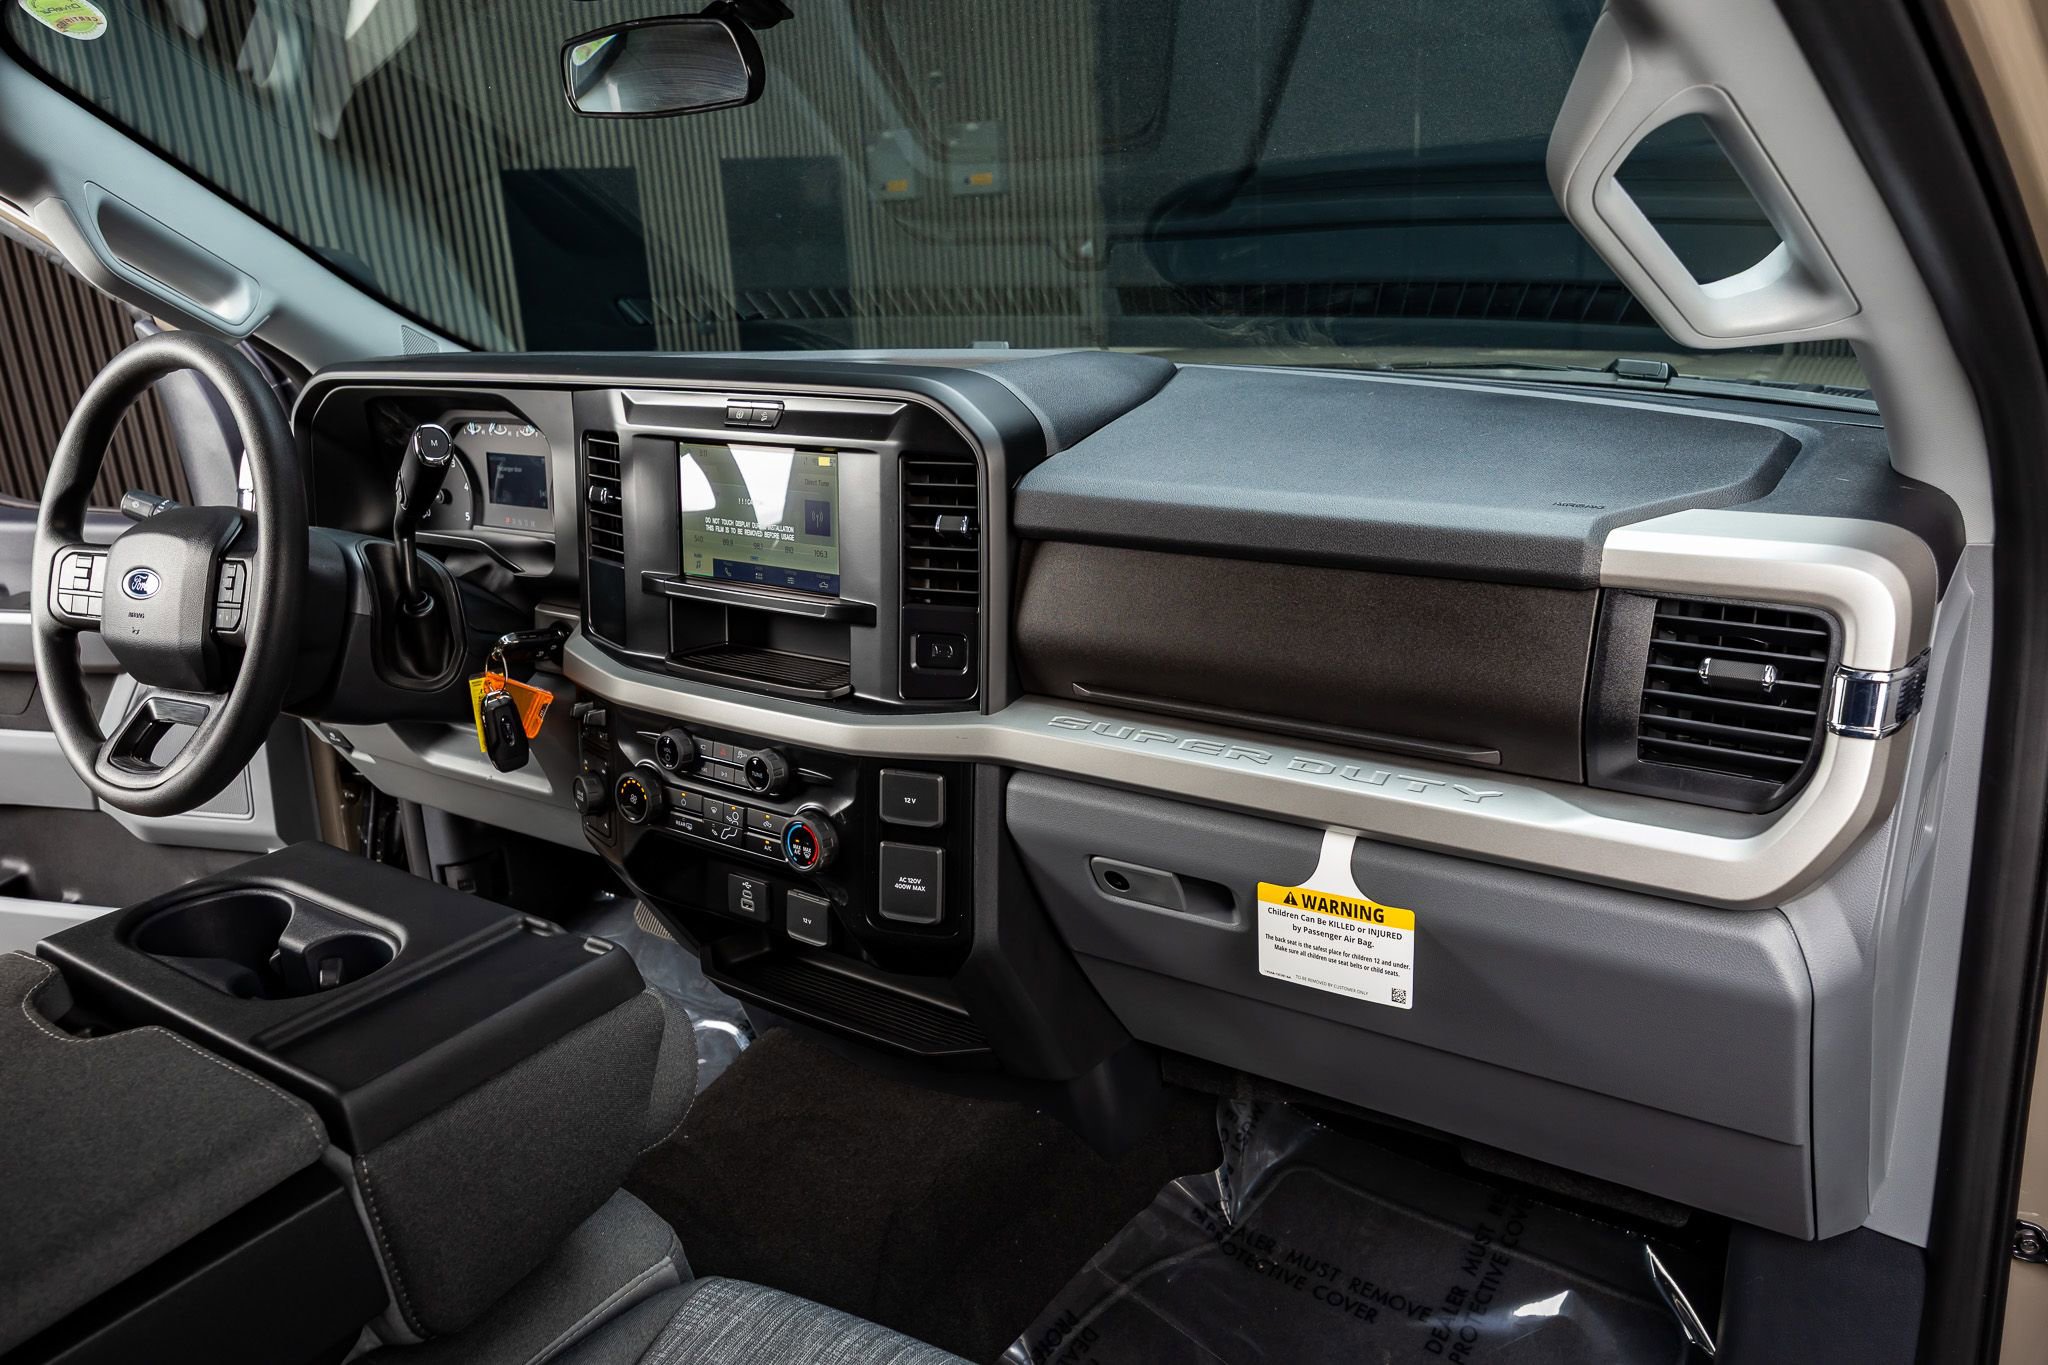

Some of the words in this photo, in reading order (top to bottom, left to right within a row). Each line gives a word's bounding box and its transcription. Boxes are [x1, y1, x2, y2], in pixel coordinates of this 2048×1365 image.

[463, 482, 469, 491] 4
[465, 512, 471, 521] 5
[704, 516, 712, 524] DO
[712, 517, 720, 525] NOT
[721, 518, 735, 527] TOUCH
[735, 520, 751, 528] DISPLAY
[705, 524, 714, 532] THIS
[715, 525, 724, 533] FILM
[744, 528, 763, 538] REMOVED
[764, 531, 780, 540] BEFORE
[780, 533, 795, 542] USAGE
[1047, 714, 1272, 766] SUPER
[1287, 756, 1504, 804] DUTY
[751, 770, 763, 779] TUNE
[675, 820, 686, 828] REAR
[802, 846, 812, 854] MAX
[894, 882, 911, 891] 400W
[912, 884, 926, 892] MAX
[907, 877, 922, 885] 120V
[1301, 893, 1385, 924] WARNING
[1267, 907, 1299, 920] Children
[1300, 914, 1315, 924] Can
[1317, 917, 1327, 926] Be
[1328, 920, 1356, 932] KILLED
[1368, 927, 1403, 940] INJURED
[1292, 923, 1302, 933] by
[1303, 926, 1342, 941] Passenger
[1344, 935, 1355, 943] Air
[1357, 937, 1375, 948] Bag.
[1265, 933, 1274, 941] The
[1275, 936, 1286, 944] back
[1313, 944, 1328, 953] safest
[1328, 948, 1341, 956] place
[1342, 950, 1350, 958] for
[1351, 953, 1373, 963] children
[1381, 959, 1392, 967] and
[1393, 962, 1411, 970] under.
[1274, 944, 1288, 953] Make
[1307, 952, 1328, 961] children
[1349, 961, 1363, 970] belts
[1370, 966, 1384, 974] child
[1384, 969, 1400, 977] seats.
[1308, 977, 1327, 987] REMOVED
[1333, 983, 1356, 993] CUSTOMER
[1356, 987, 1369, 996] ONLY
[1285, 1249, 1342, 1282] MUST
[1348, 1276, 1433, 1322] REMOVE
[1424, 1285, 1469, 1355] DEALER
[1461, 1222, 1495, 1277] MUST
[1313, 1284, 1379, 1324] COVER
[1448, 1252, 1510, 1365] PROTECTIVE
